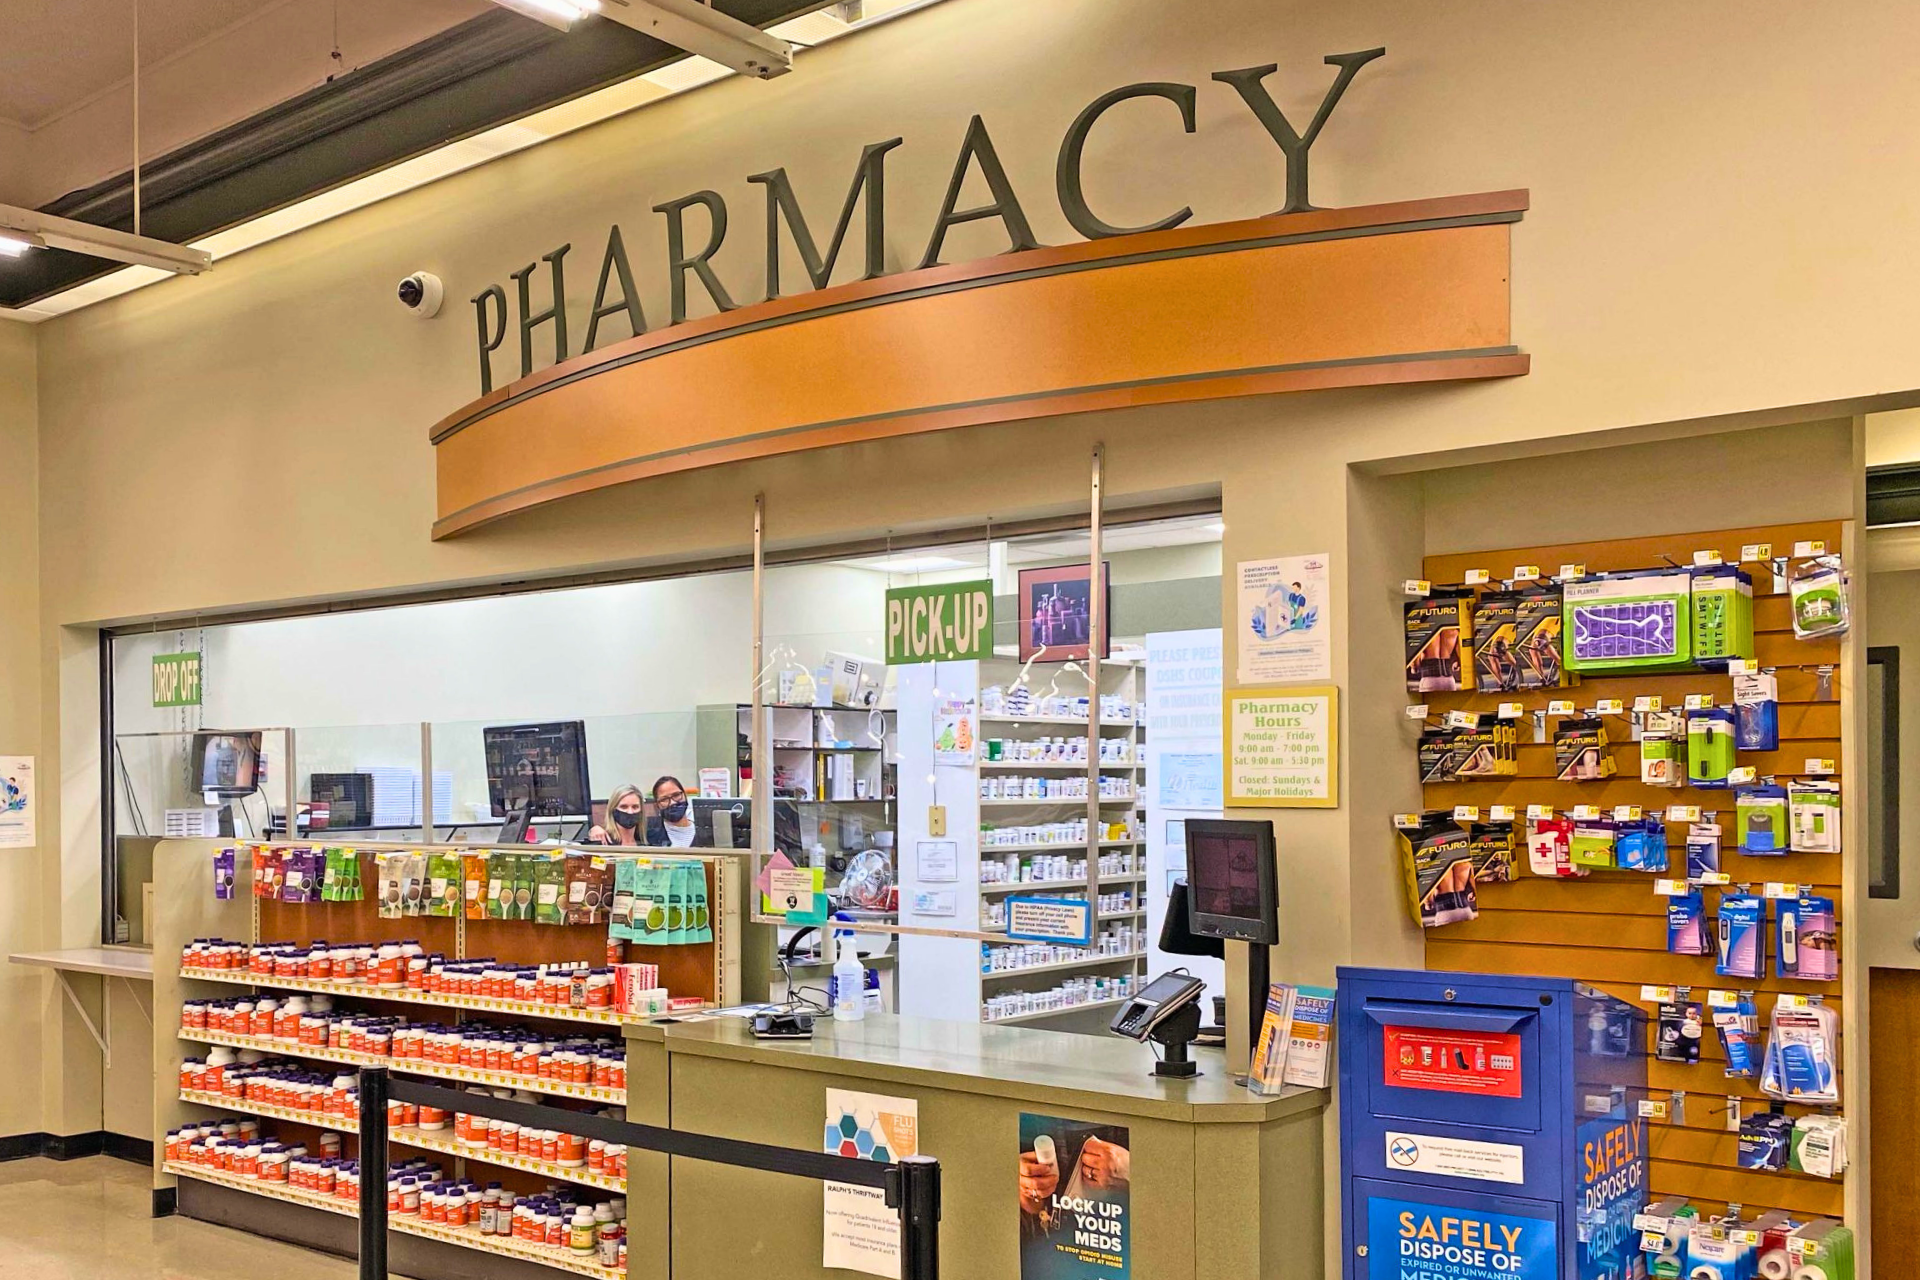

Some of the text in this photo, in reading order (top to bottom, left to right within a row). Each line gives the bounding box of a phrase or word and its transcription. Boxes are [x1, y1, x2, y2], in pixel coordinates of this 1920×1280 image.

[470, 47, 1387, 393] PHARMACY
[1527, 600, 1559, 608] FUTURO
[1420, 607, 1457, 616] FUTURO
[1484, 608, 1514, 616] FUTURO
[889, 591, 988, 658] PICK-UP
[1150, 647, 1189, 663] PLEASE
[154, 660, 199, 703] DROP OFF
[1239, 702, 1318, 715] Pharmacy
[1255, 716, 1301, 727] Hours
[1243, 732, 1278, 742] Monday
[1286, 731, 1316, 741] Friday
[1283, 744, 1302, 752] 7:00
[1305, 745, 1319, 754] pm
[1234, 757, 1249, 765] Sat.
[1251, 757, 1268, 765] 9:00
[1291, 756, 1309, 765] 5:30
[1311, 757, 1325, 766] pm
[1239, 775, 1320, 786] Closed: Sundays &
[1246, 787, 1314, 796] Major Holidays
[1429, 841, 1467, 854] FUTURO
[1296, 998, 1330, 1009] SAFELY
[894, 1116, 913, 1128] FLU
[1584, 1117, 1642, 1184] SAFELY
[828, 1185, 883, 1200] RALPH'S THRIFTWAY
[1586, 1169, 1627, 1215] DISPOSE
[1629, 1160, 1642, 1189] OF
[1052, 1193, 1123, 1218] LOCK UP
[1074, 1214, 1122, 1236] YOUR
[1399, 1211, 1523, 1253] SAFELY
[1074, 1230, 1122, 1252] MEDS
[1700, 1243, 1724, 1253] Nexcare
[1400, 1239, 1522, 1272] DISPOSE OF
[1401, 1258, 1443, 1272] EXPIRED
[1445, 1264, 1460, 1276] OR
[1462, 1267, 1522, 1280] UNWANTED
